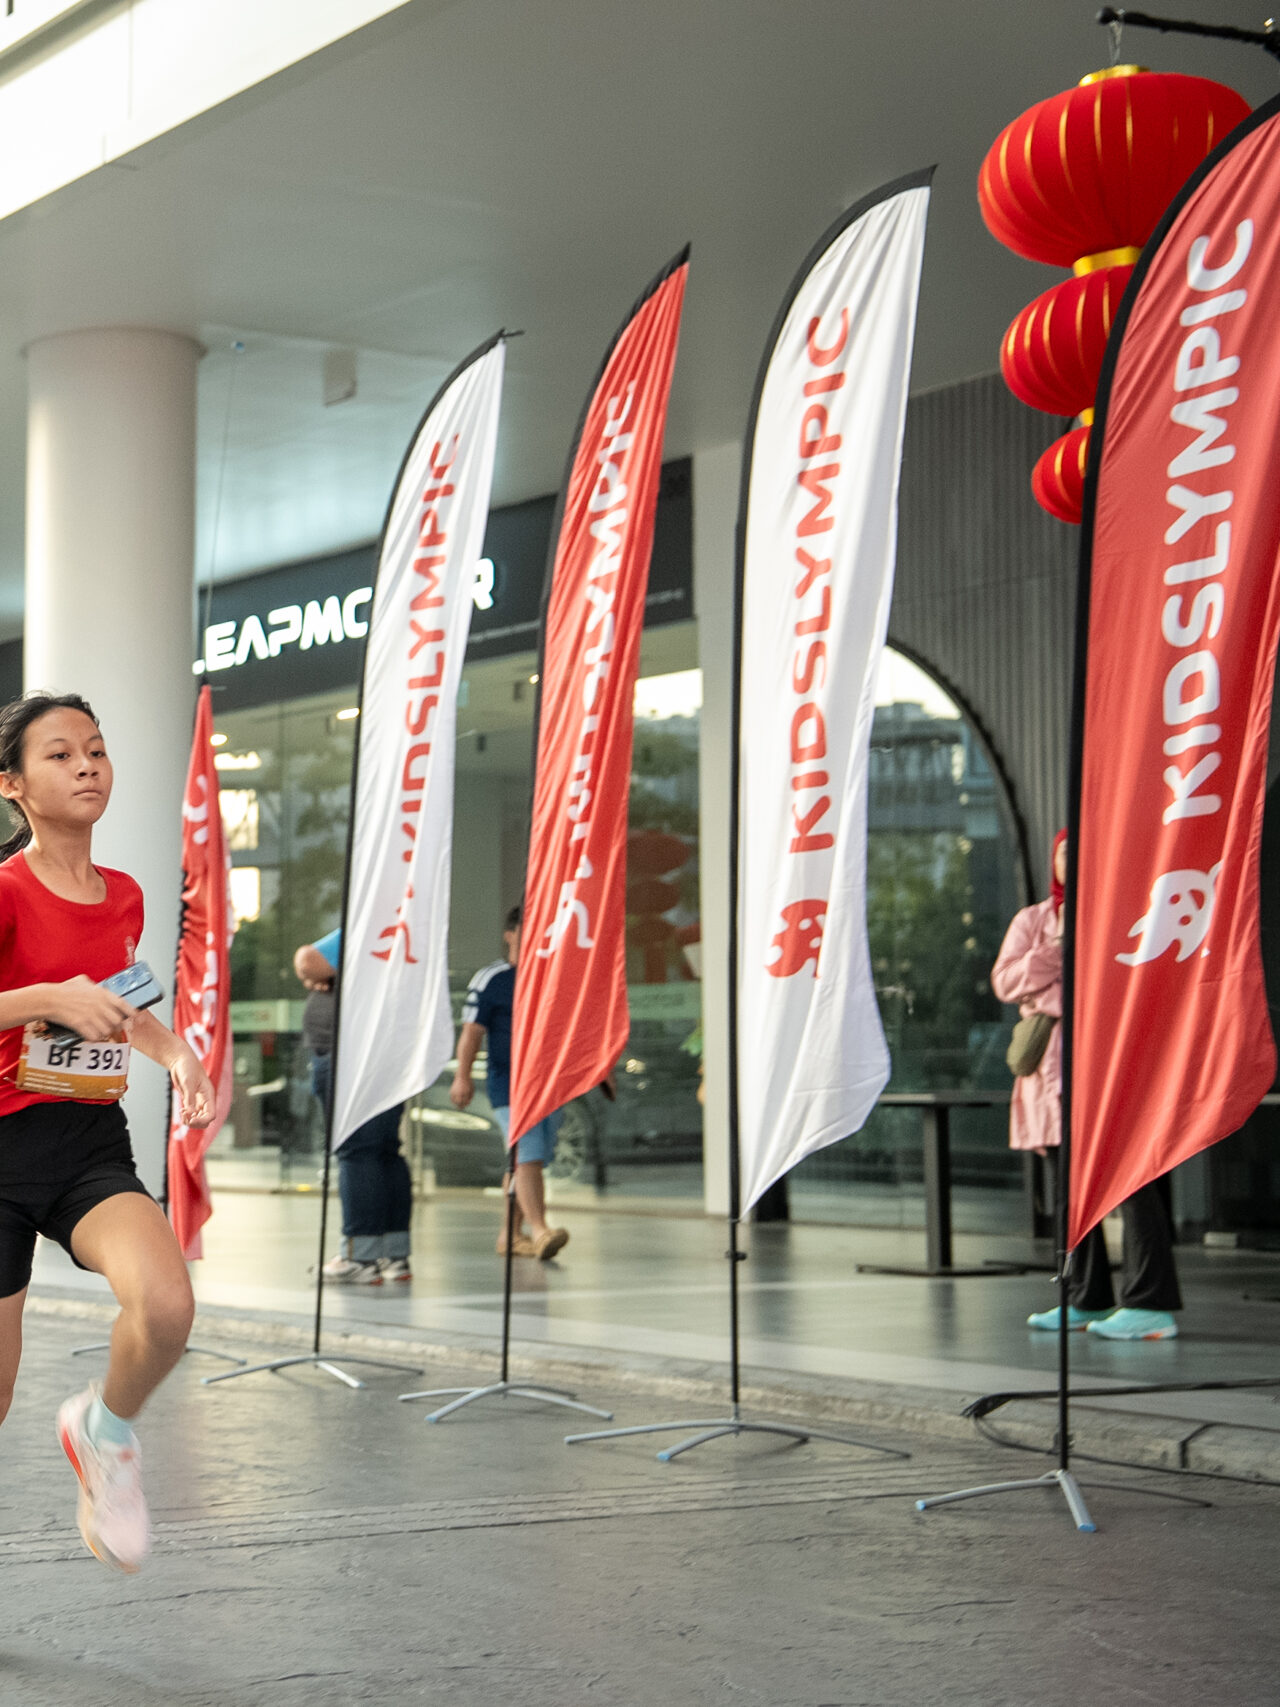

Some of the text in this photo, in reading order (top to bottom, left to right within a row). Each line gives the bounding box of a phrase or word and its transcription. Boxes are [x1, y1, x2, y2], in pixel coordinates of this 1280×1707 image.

[788, 306, 850, 855] KIDSLYMPIC
[1161, 217, 1254, 826] KIDSLYMPIC
[48, 1043, 123, 1070] BF 392
